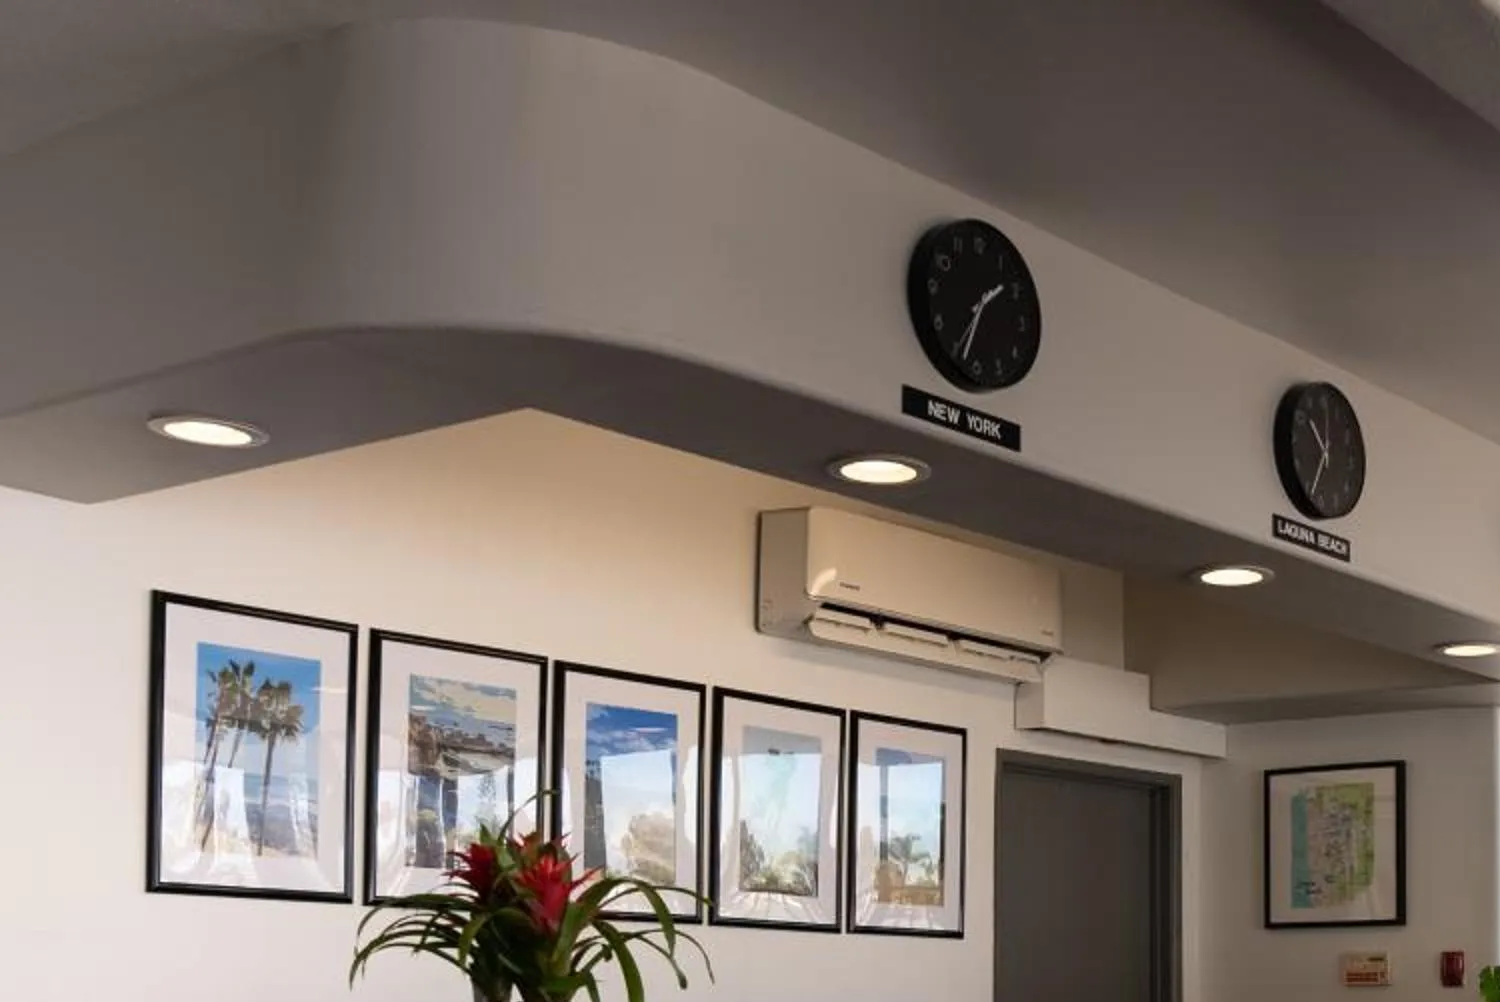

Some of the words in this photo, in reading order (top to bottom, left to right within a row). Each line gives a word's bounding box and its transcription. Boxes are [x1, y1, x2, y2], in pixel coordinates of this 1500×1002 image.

[927, 400, 960, 425] NEW
[966, 412, 1001, 439] YORK
[1277, 519, 1315, 545] LAGUNA
[1318, 533, 1347, 556] BEACH
